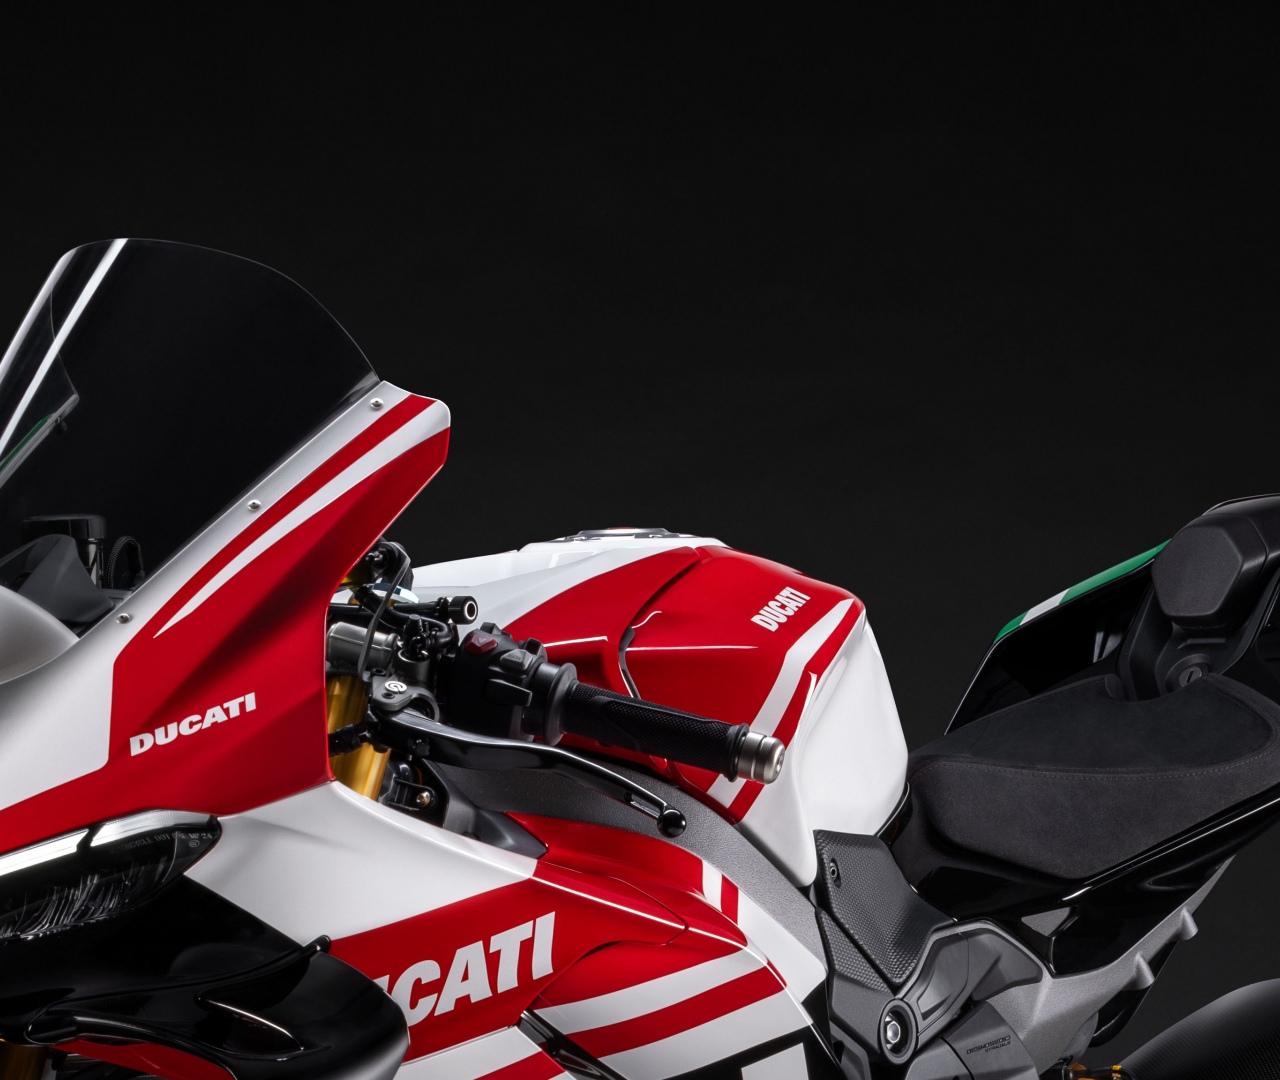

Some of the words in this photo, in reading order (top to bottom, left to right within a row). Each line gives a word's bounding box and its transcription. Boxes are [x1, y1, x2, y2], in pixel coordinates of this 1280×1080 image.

[750, 586, 811, 632] DUCATI
[130, 692, 257, 757] DUCATI
[372, 911, 556, 1028] CATI
